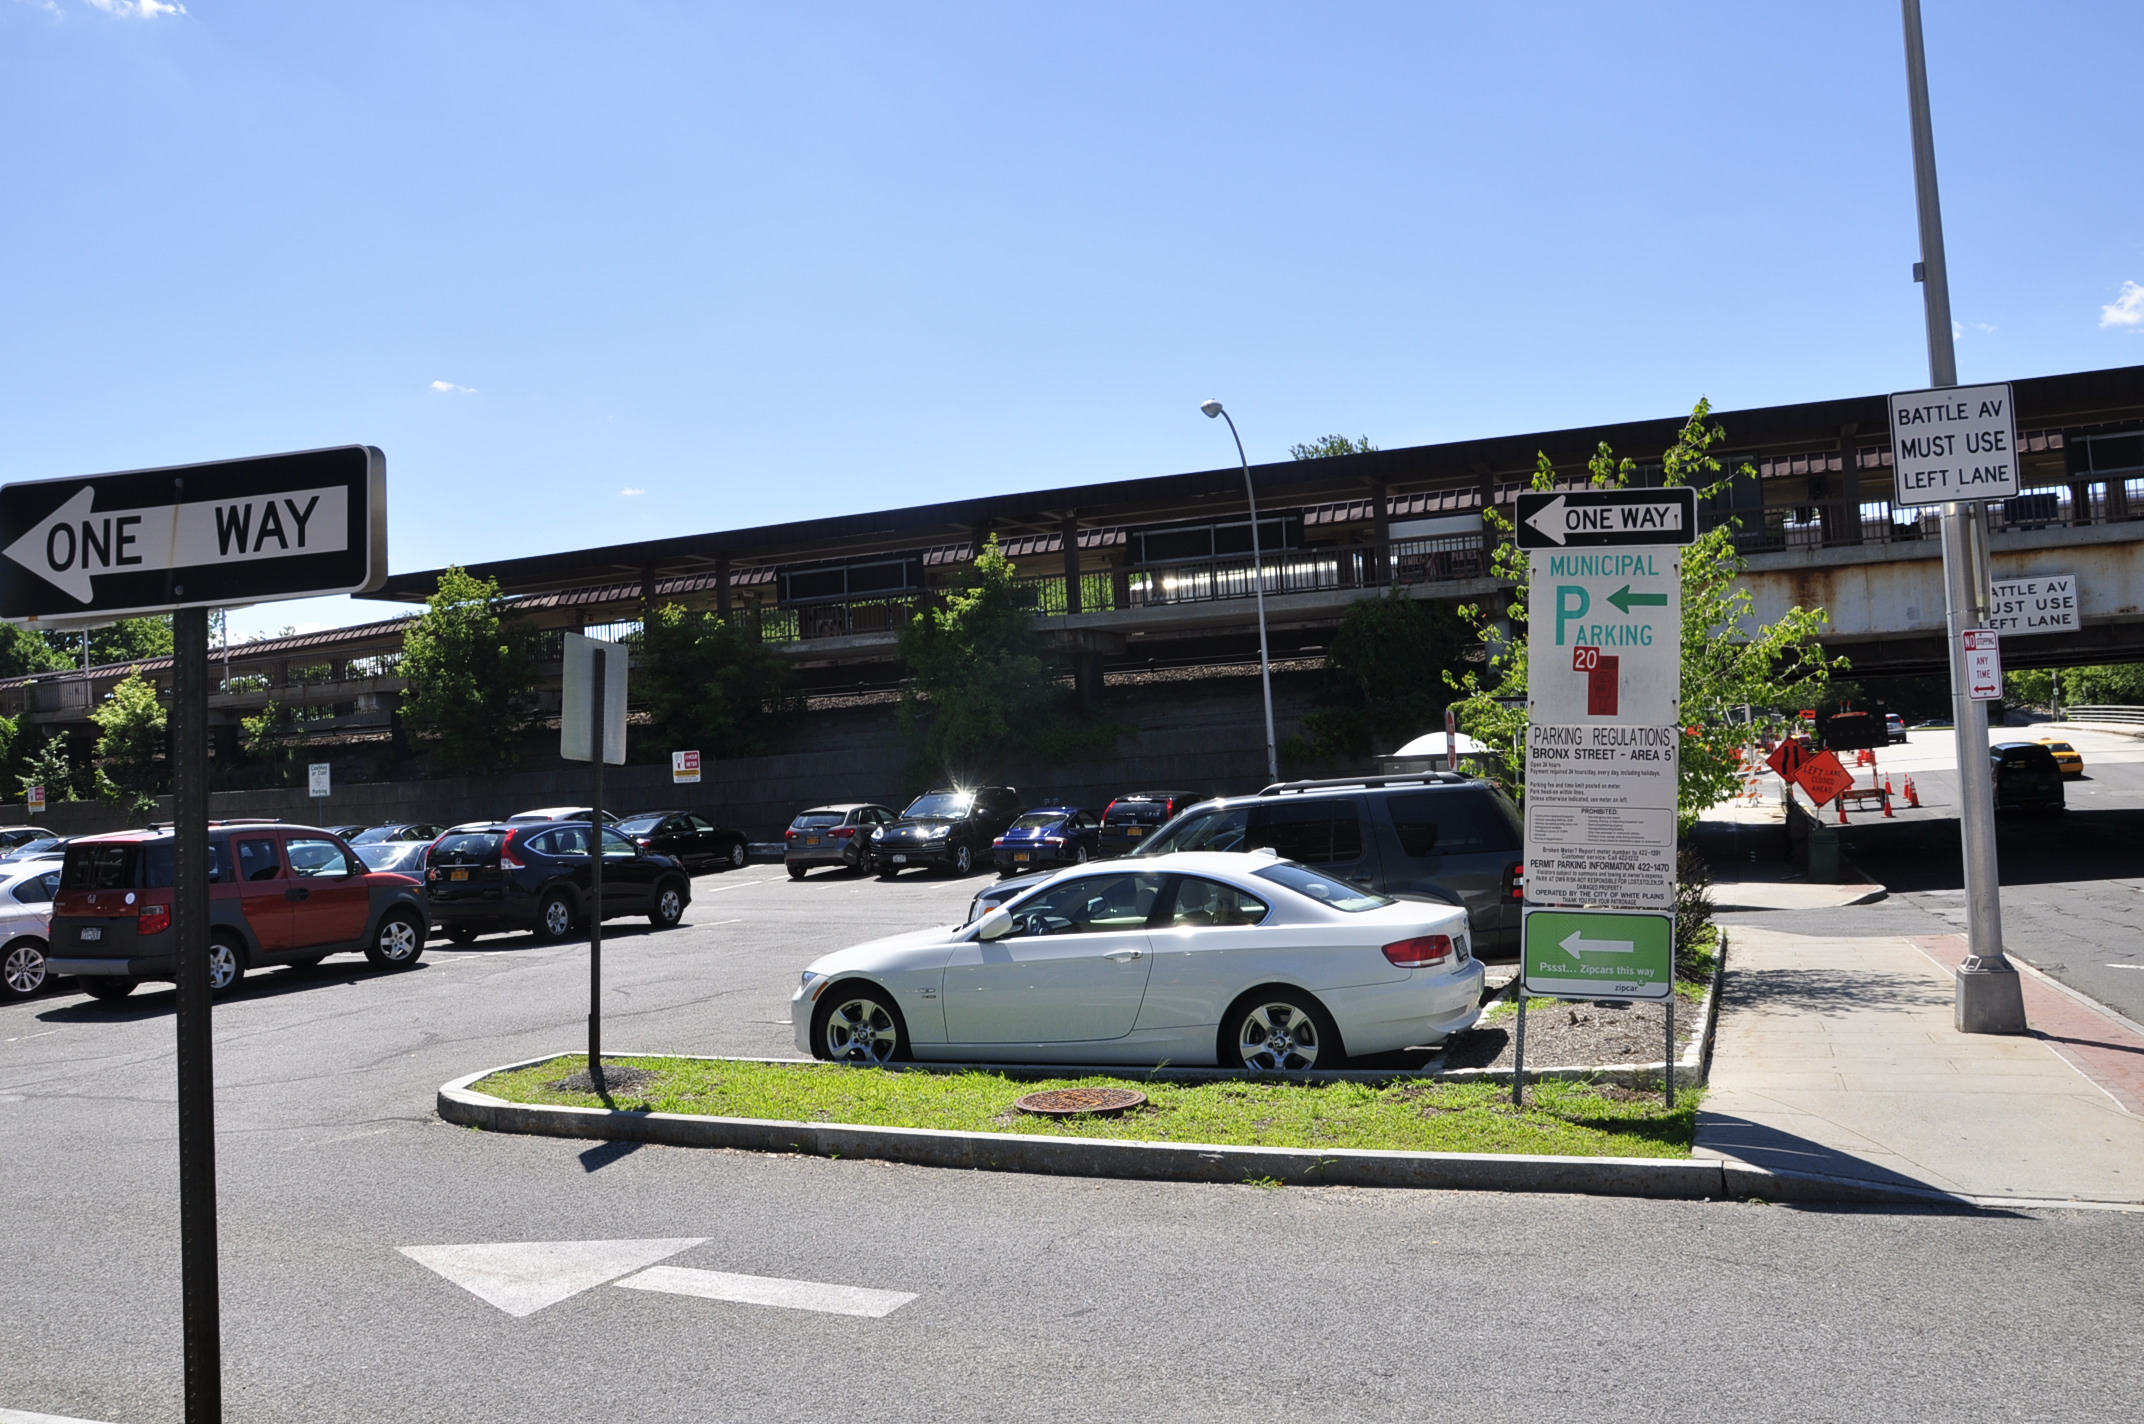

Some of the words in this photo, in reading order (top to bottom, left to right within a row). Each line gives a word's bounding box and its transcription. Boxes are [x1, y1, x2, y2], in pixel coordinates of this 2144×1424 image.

[1900, 403, 1968, 426] BATTLE
[1979, 400, 2002, 418] AV
[1902, 435, 1955, 459] MUST
[1966, 431, 2006, 454] USE
[1905, 470, 1949, 489] LEFT
[1959, 465, 2009, 485] LANE
[1566, 508, 1613, 531] ONE
[1621, 507, 1670, 529] WAY
[47, 516, 143, 572] ONE
[216, 496, 320, 556] WAY
[1551, 555, 1660, 577] MUNICIPAL
[1992, 584, 2037, 597] ATTLE
[2047, 581, 2067, 593] AV
[1993, 601, 2024, 614] UST
[2036, 597, 2073, 610] USE
[1556, 585, 1653, 646] PARKING
[1980, 618, 2018, 629] LEFT
[2028, 614, 2071, 627] LANE
[1965, 636, 1975, 648] NO
[1977, 637, 1994, 645] STOPPING
[1575, 650, 1597, 669] 20
[1977, 657, 1988, 665] ANY
[1976, 670, 1991, 678] TIME
[1535, 727, 1582, 745] PARKING
[1593, 728, 1670, 746] REGULATIONS
[1533, 749, 1569, 760] BRONX
[1575, 749, 1616, 760] STREET
[1631, 750, 1660, 761] AREA
[1664, 751, 1671, 761] 5
[1804, 765, 1823, 776] LEFT
[1812, 776, 1834, 785] CLOSED
[1531, 859, 1555, 868] PERMIT
[1558, 860, 1586, 869] PARKING
[1589, 861, 1635, 871] INFORMATION
[1638, 863, 1669, 872] 422-1470
[1540, 962, 1576, 973] Pssst...
[1580, 965, 1614, 974] Zipcars
[1617, 966, 1634, 975] this
[1637, 968, 1654, 977] way
[1615, 984, 1638, 992] zipcar
